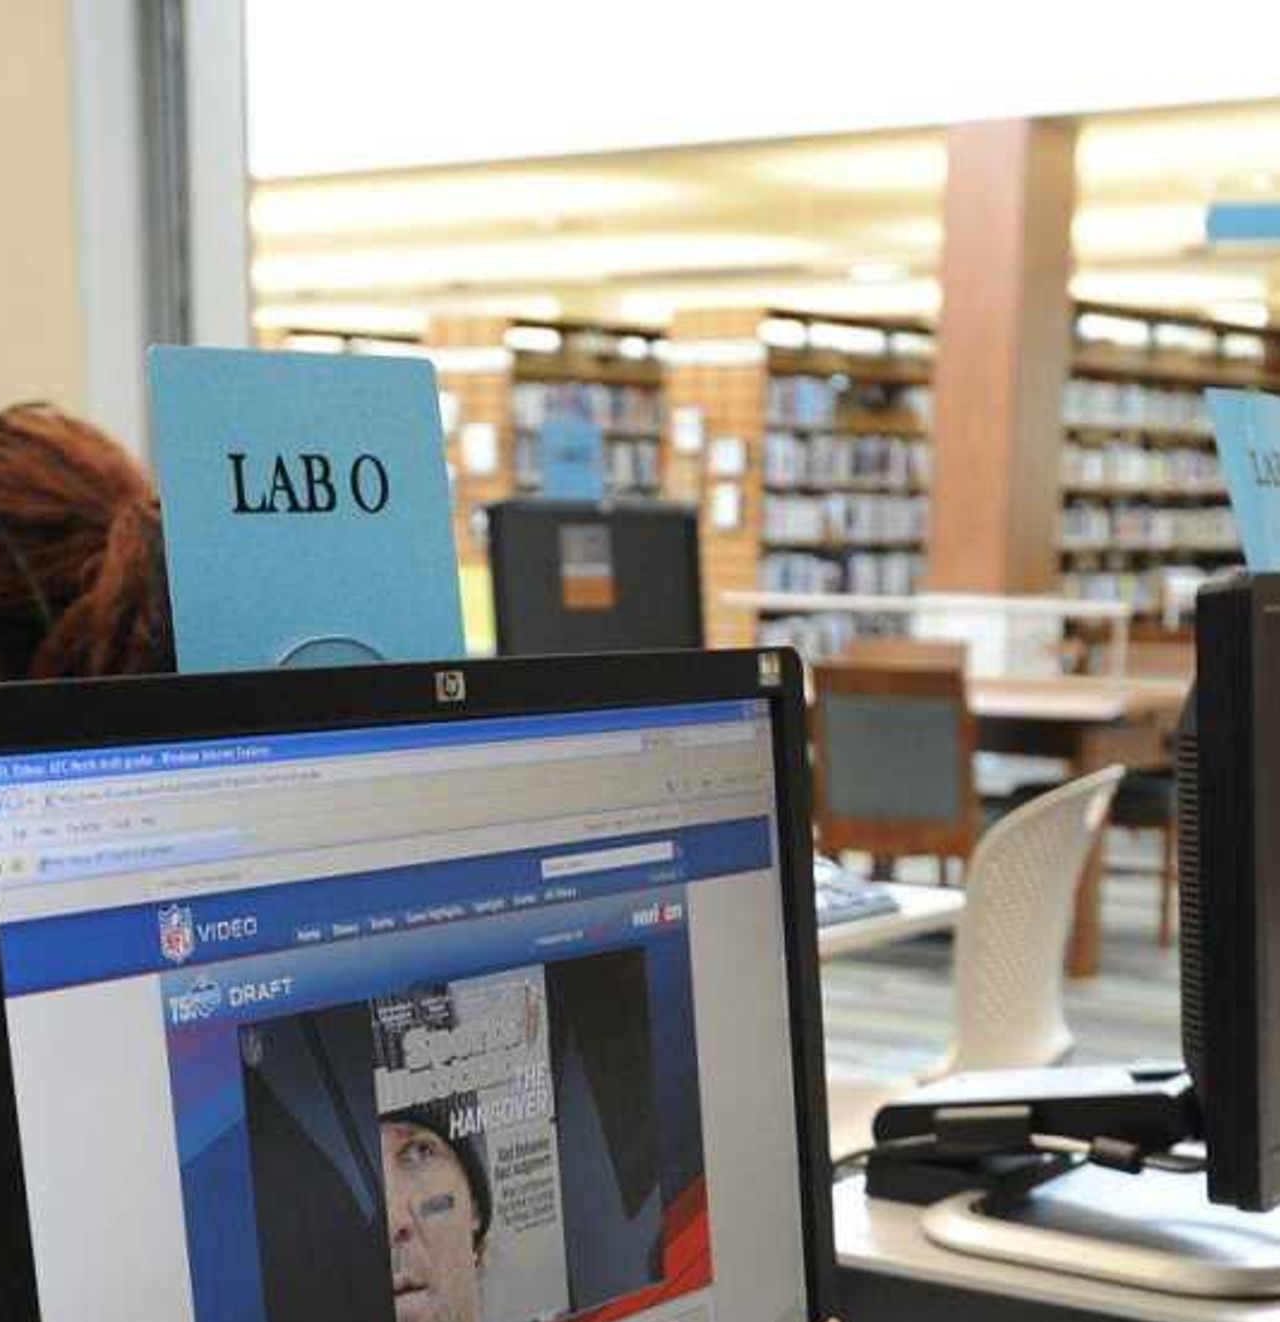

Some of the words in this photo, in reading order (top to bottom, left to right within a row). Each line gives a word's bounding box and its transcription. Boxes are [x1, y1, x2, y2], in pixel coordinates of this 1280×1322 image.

[226, 452, 337, 514] LAB
[350, 453, 389, 514] O
[196, 916, 257, 943] VIDEO
[228, 978, 294, 1008] DRAFT
